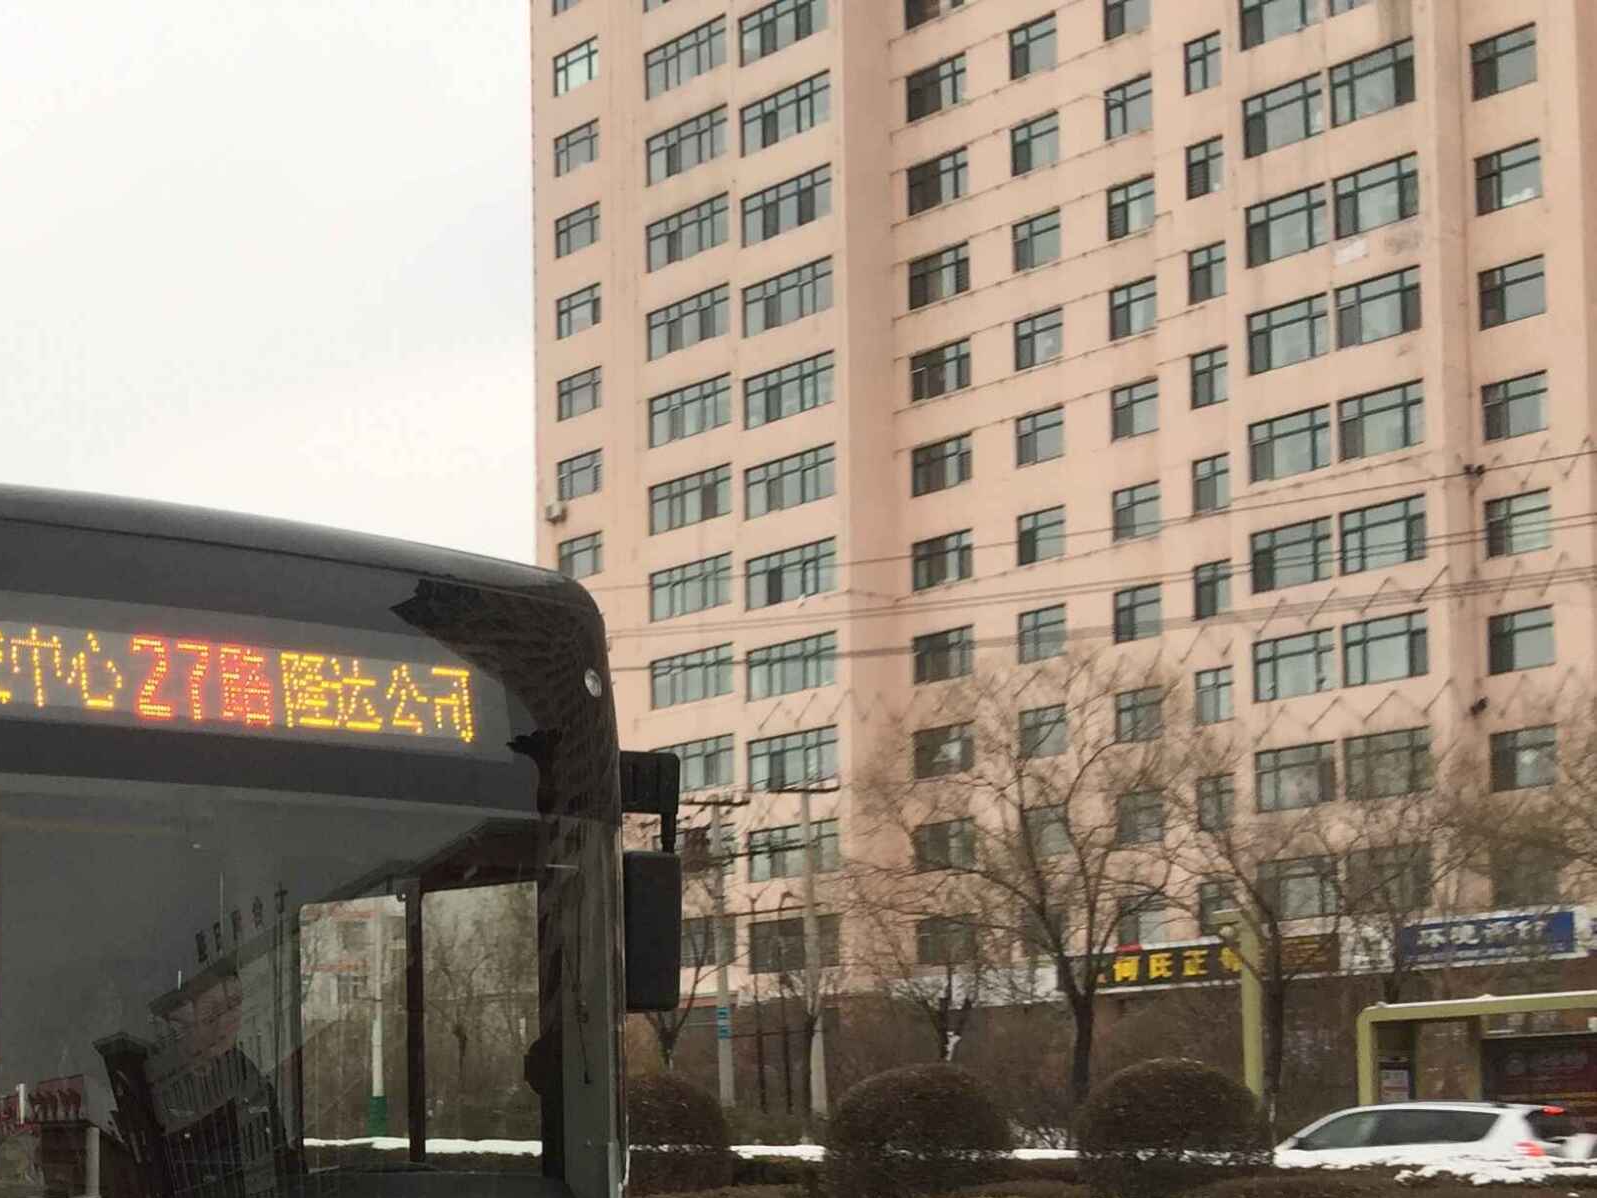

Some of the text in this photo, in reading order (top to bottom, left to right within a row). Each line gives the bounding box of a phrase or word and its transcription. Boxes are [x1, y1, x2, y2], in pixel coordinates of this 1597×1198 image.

[132, 635, 272, 728] 27路
[280, 652, 474, 742] 隆达公司
